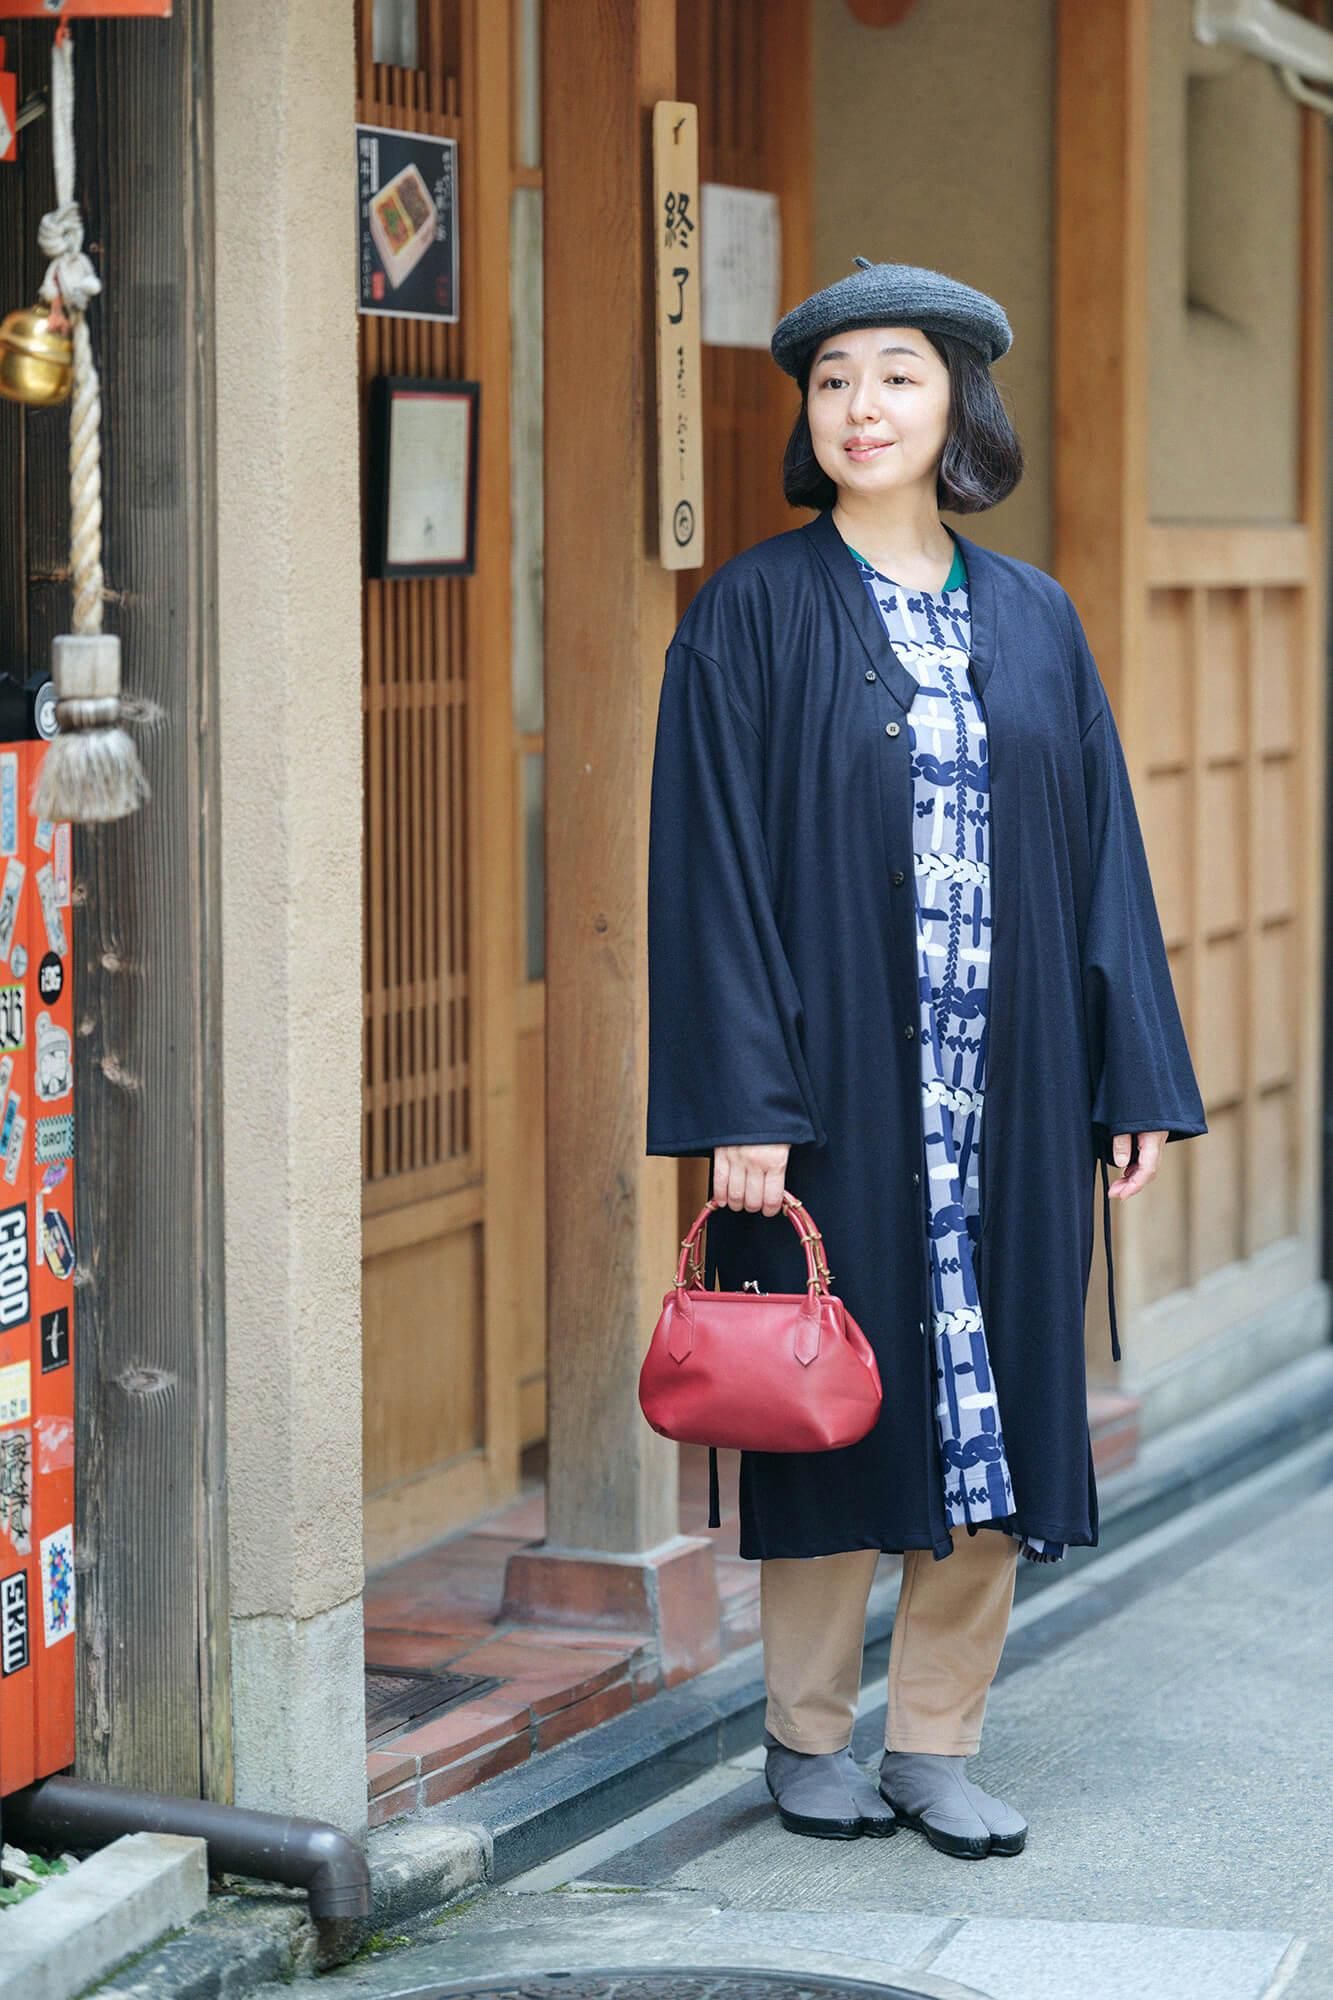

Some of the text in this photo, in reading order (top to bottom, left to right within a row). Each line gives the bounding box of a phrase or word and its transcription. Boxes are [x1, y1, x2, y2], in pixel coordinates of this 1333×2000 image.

[664, 191, 694, 325] 終了
[42, 1130, 67, 1147] GROT
[0, 1210, 29, 1325] CROD
